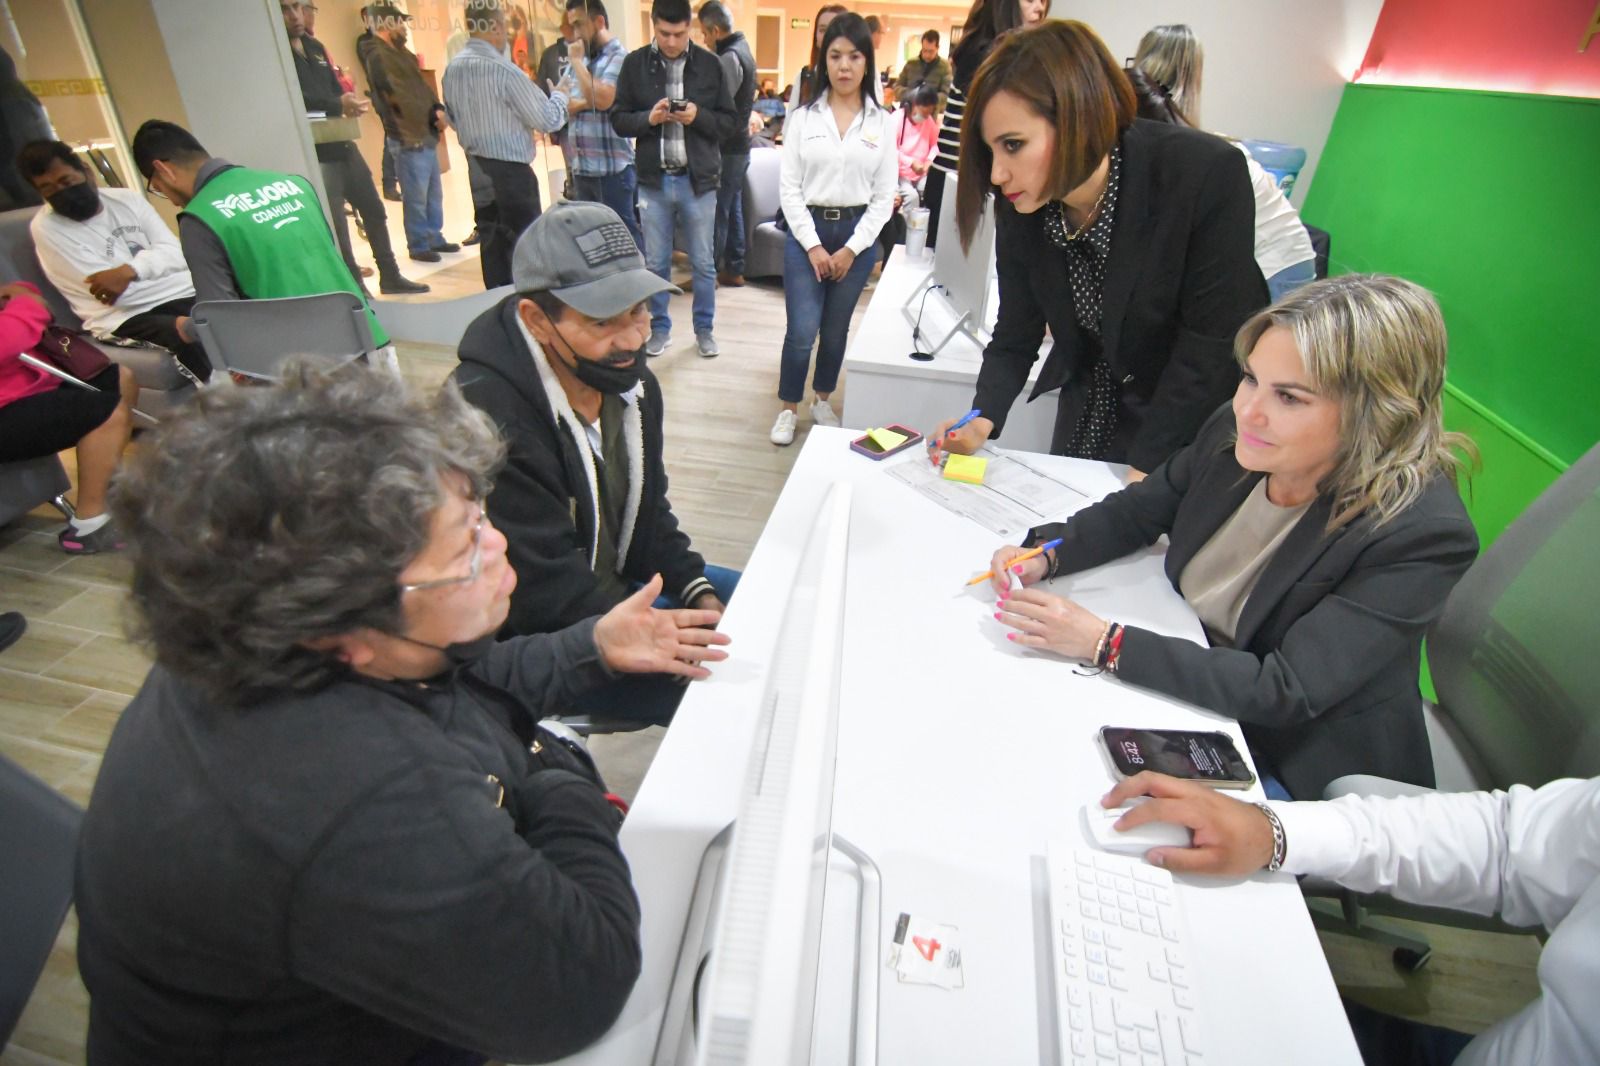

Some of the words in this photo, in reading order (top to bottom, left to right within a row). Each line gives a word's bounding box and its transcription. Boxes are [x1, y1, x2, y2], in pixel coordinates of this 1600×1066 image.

[211, 180, 305, 219] MEJORA
[252, 199, 306, 223] COAHUILA
[1125, 741, 1144, 764] 8:42
[912, 936, 941, 961] 4
